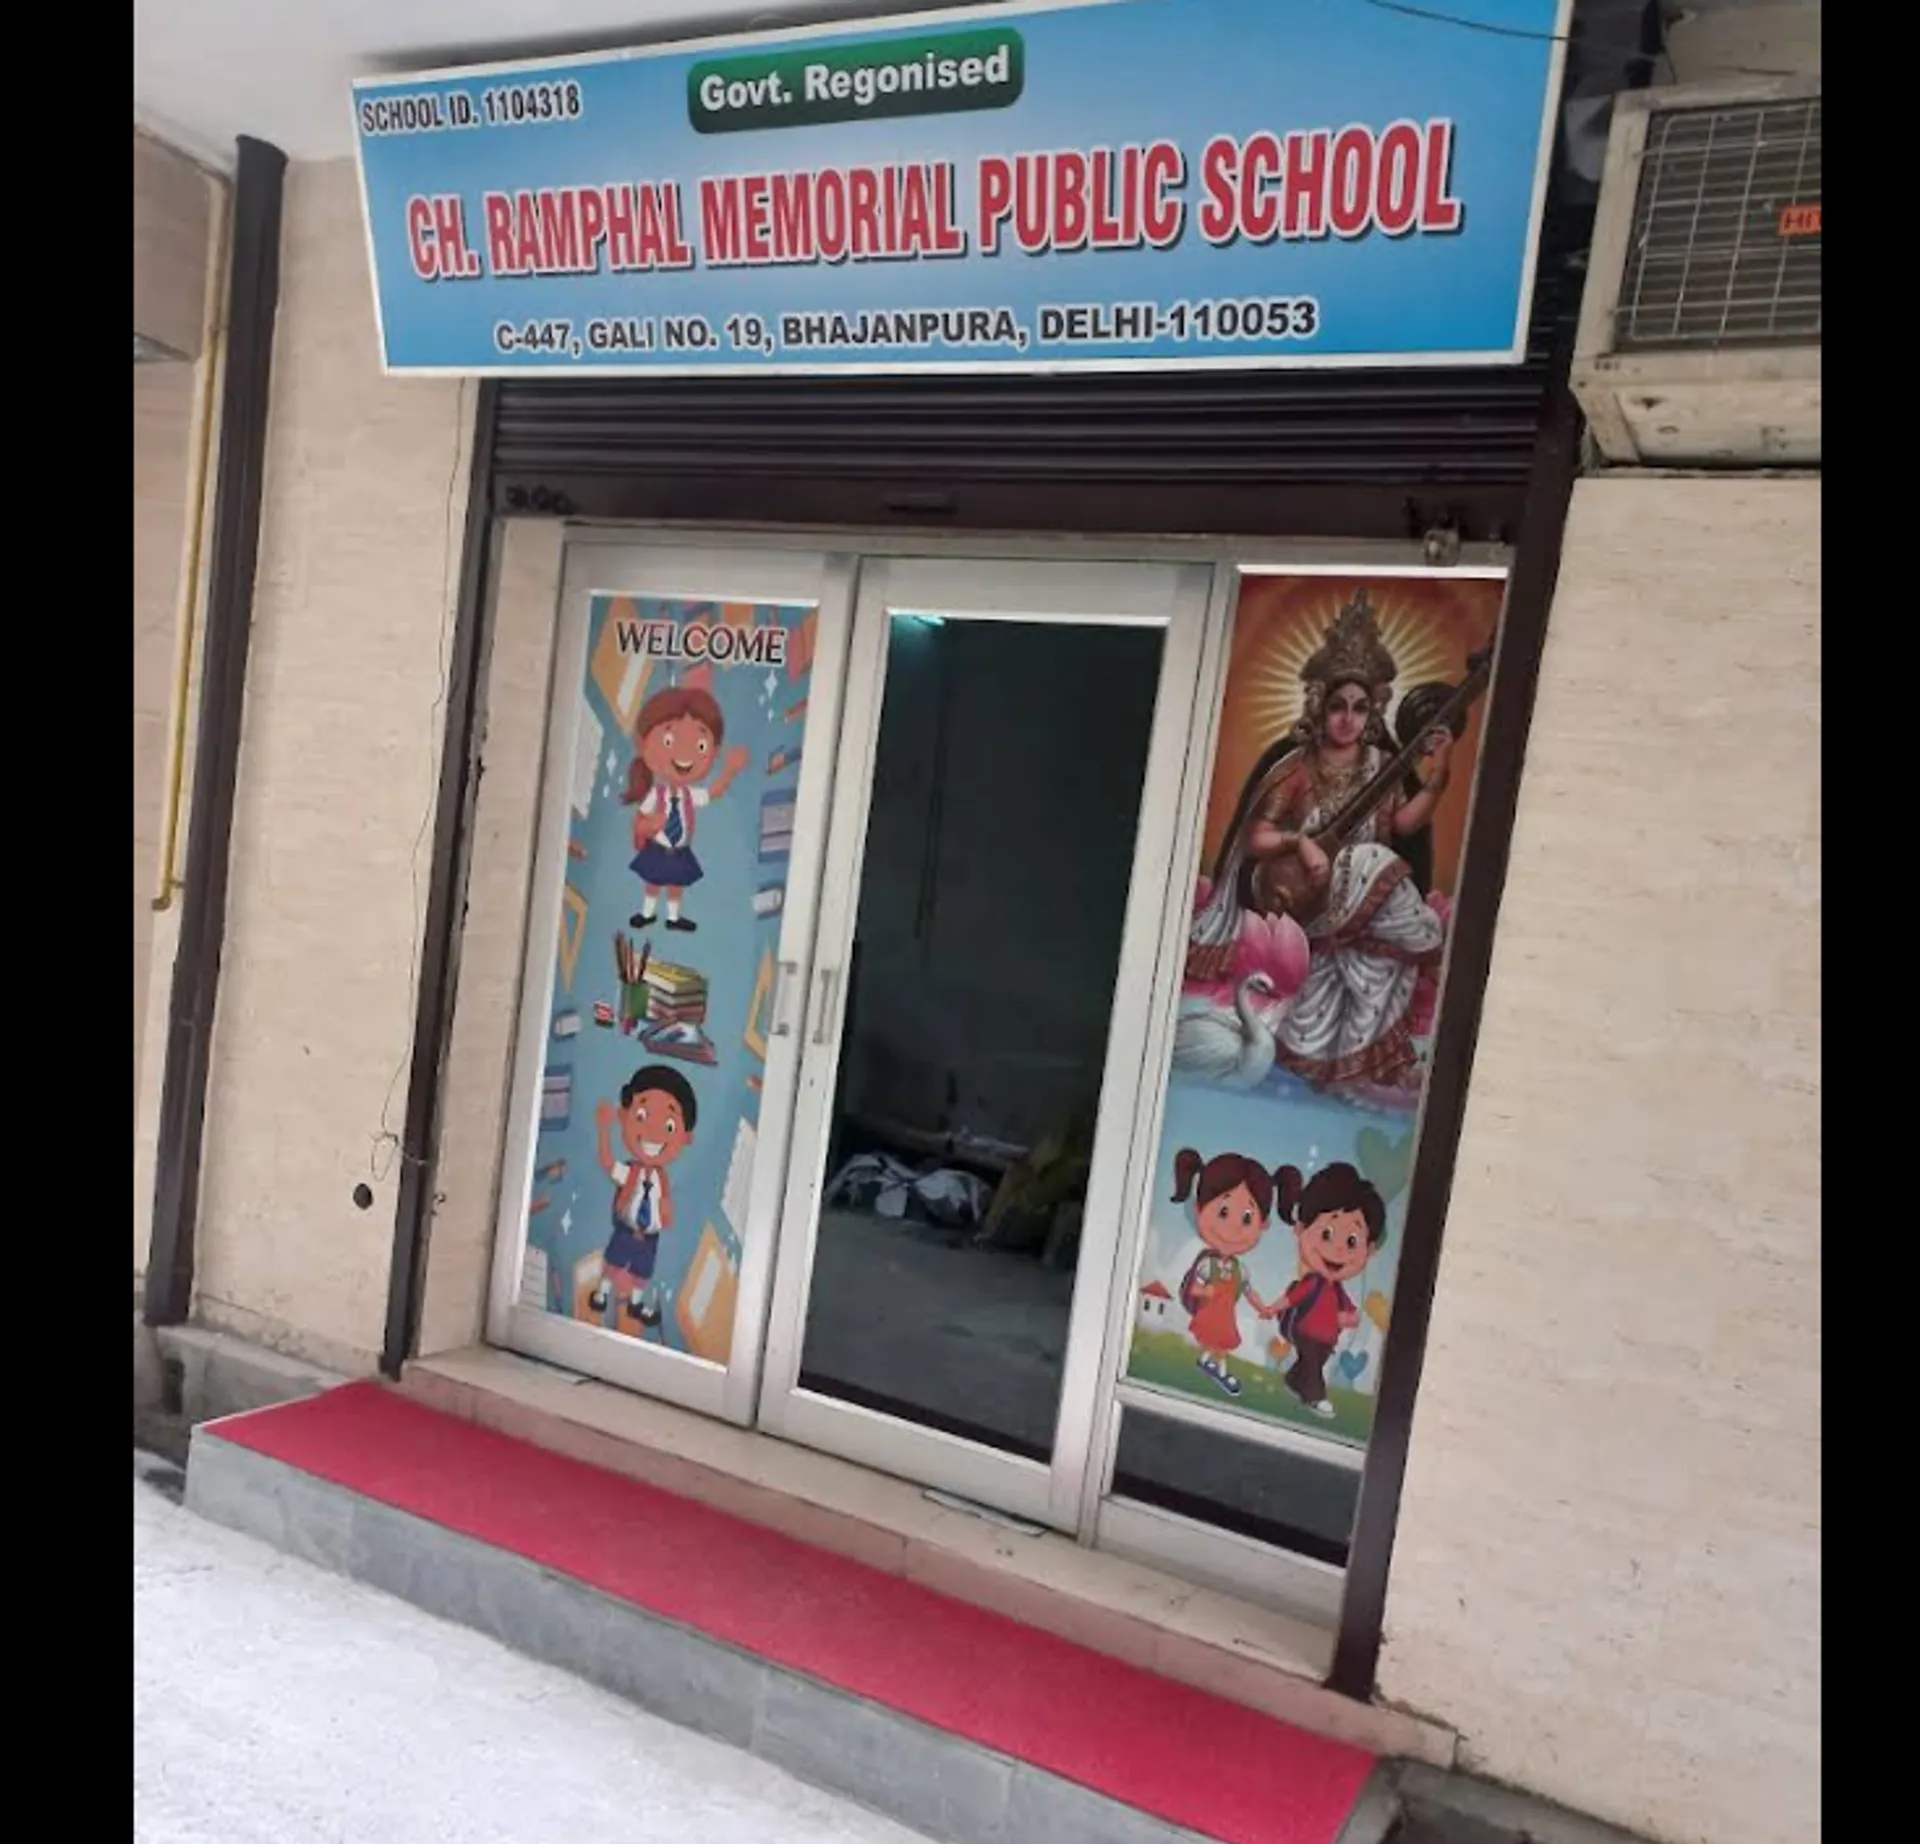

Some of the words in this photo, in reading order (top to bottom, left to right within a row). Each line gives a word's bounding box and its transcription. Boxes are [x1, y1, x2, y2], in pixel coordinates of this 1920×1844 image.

[700, 73, 791, 110] Govt.
[804, 45, 1009, 104] Regonised
[363, 97, 443, 132] SCHOOL
[450, 94, 478, 126] ID.
[485, 83, 580, 122] 1104318
[408, 196, 478, 277] CH.
[484, 182, 690, 274] RAMPHAL
[701, 162, 962, 261] MEMORIAL
[979, 143, 1183, 249] PUBLIC
[1200, 122, 1457, 241] SCHOOL
[1784, 211, 1822, 229] HI
[497, 322, 580, 355] C-447,
[588, 320, 654, 350] GALI
[664, 317, 716, 348] NO.
[726, 319, 772, 354] 19,
[783, 309, 1027, 347] BHAJANPURA,
[1040, 301, 1316, 341] DELHI-110053
[616, 620, 786, 665] WELCOME
